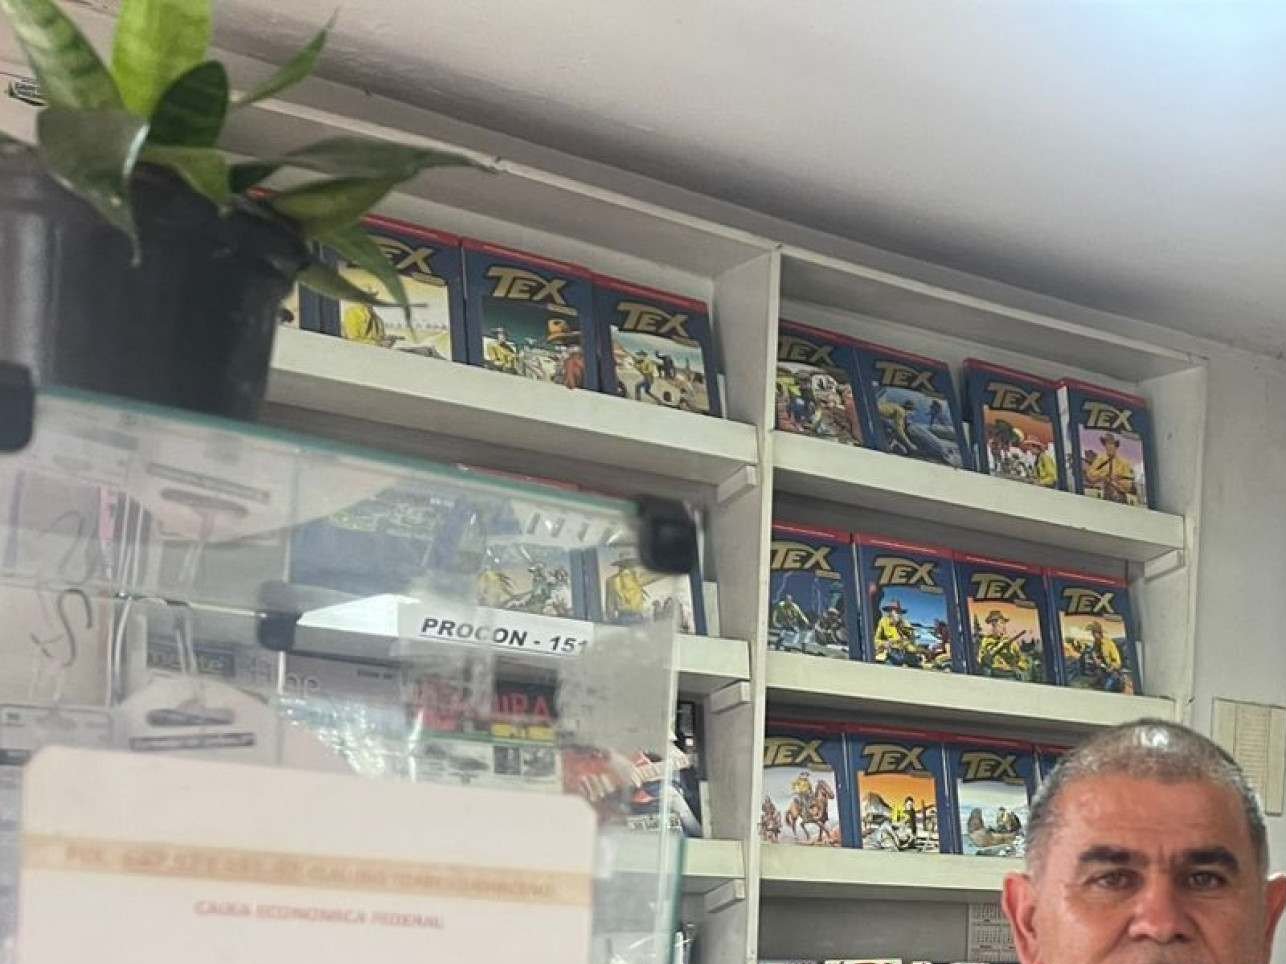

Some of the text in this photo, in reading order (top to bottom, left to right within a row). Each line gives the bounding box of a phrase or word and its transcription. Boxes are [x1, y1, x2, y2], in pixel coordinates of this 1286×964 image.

[486, 266, 567, 304] TEX
[617, 303, 690, 335] TEX
[778, 334, 835, 365] TEX
[876, 360, 936, 389] TEX
[988, 383, 1041, 412] TEX
[1083, 401, 1132, 430] TEX
[772, 540, 832, 570] TEX
[874, 557, 938, 586] TEX
[971, 574, 1027, 600] TEX
[1063, 588, 1115, 614] TEX
[421, 617, 527, 646] PROCON
[765, 737, 824, 766] TEX
[864, 744, 924, 770] TEX
[962, 752, 1019, 778] TEX
